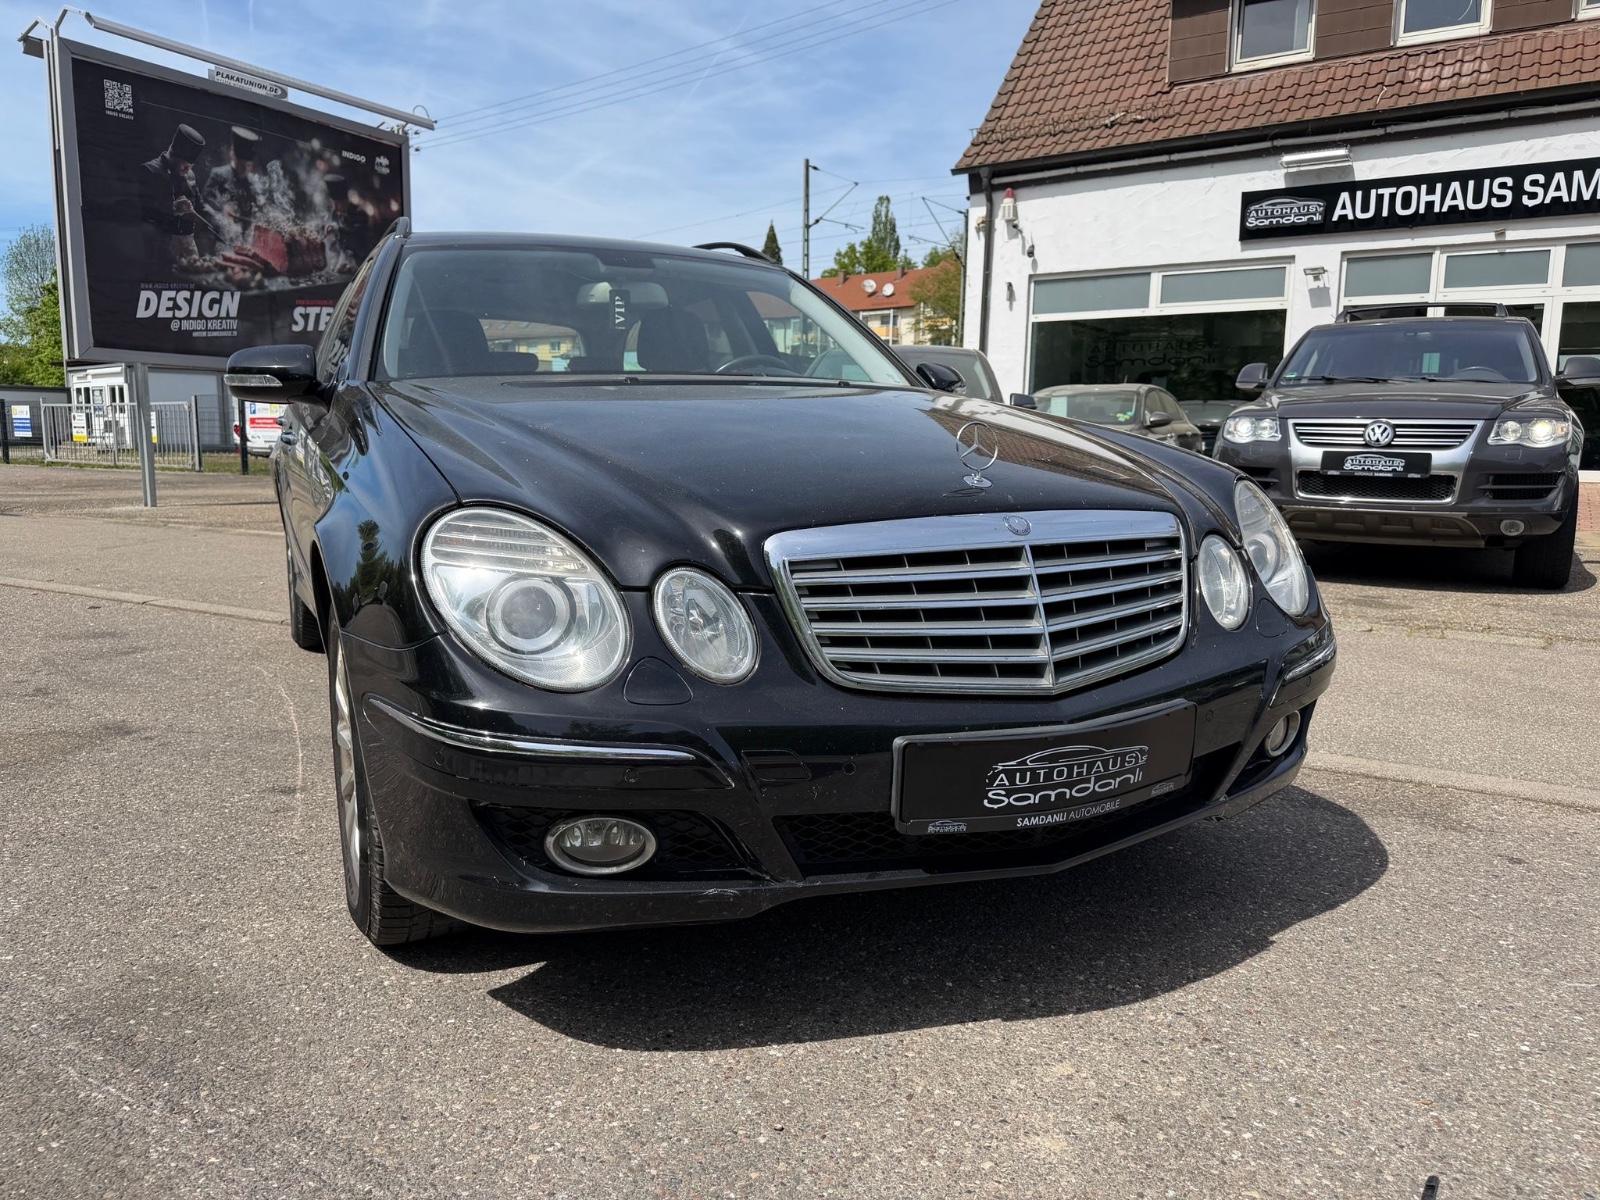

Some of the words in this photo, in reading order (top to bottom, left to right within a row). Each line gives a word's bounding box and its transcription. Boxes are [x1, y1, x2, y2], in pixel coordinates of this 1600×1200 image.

[215, 70, 279, 94] PLAKATUNION.DE
[341, 150, 366, 162] INDIGO
[1249, 205, 1318, 218] AUTOHAUS
[1331, 176, 1513, 222] AUTOHAUS
[135, 289, 241, 319] DESIGN
[181, 319, 206, 331] INDIGO
[207, 319, 238, 331] KREATIV
[993, 753, 1137, 787] AUTOHAUS
[1016, 812, 1067, 827] SAMDANLI
[1068, 799, 1121, 820] AUTOMOBILE
